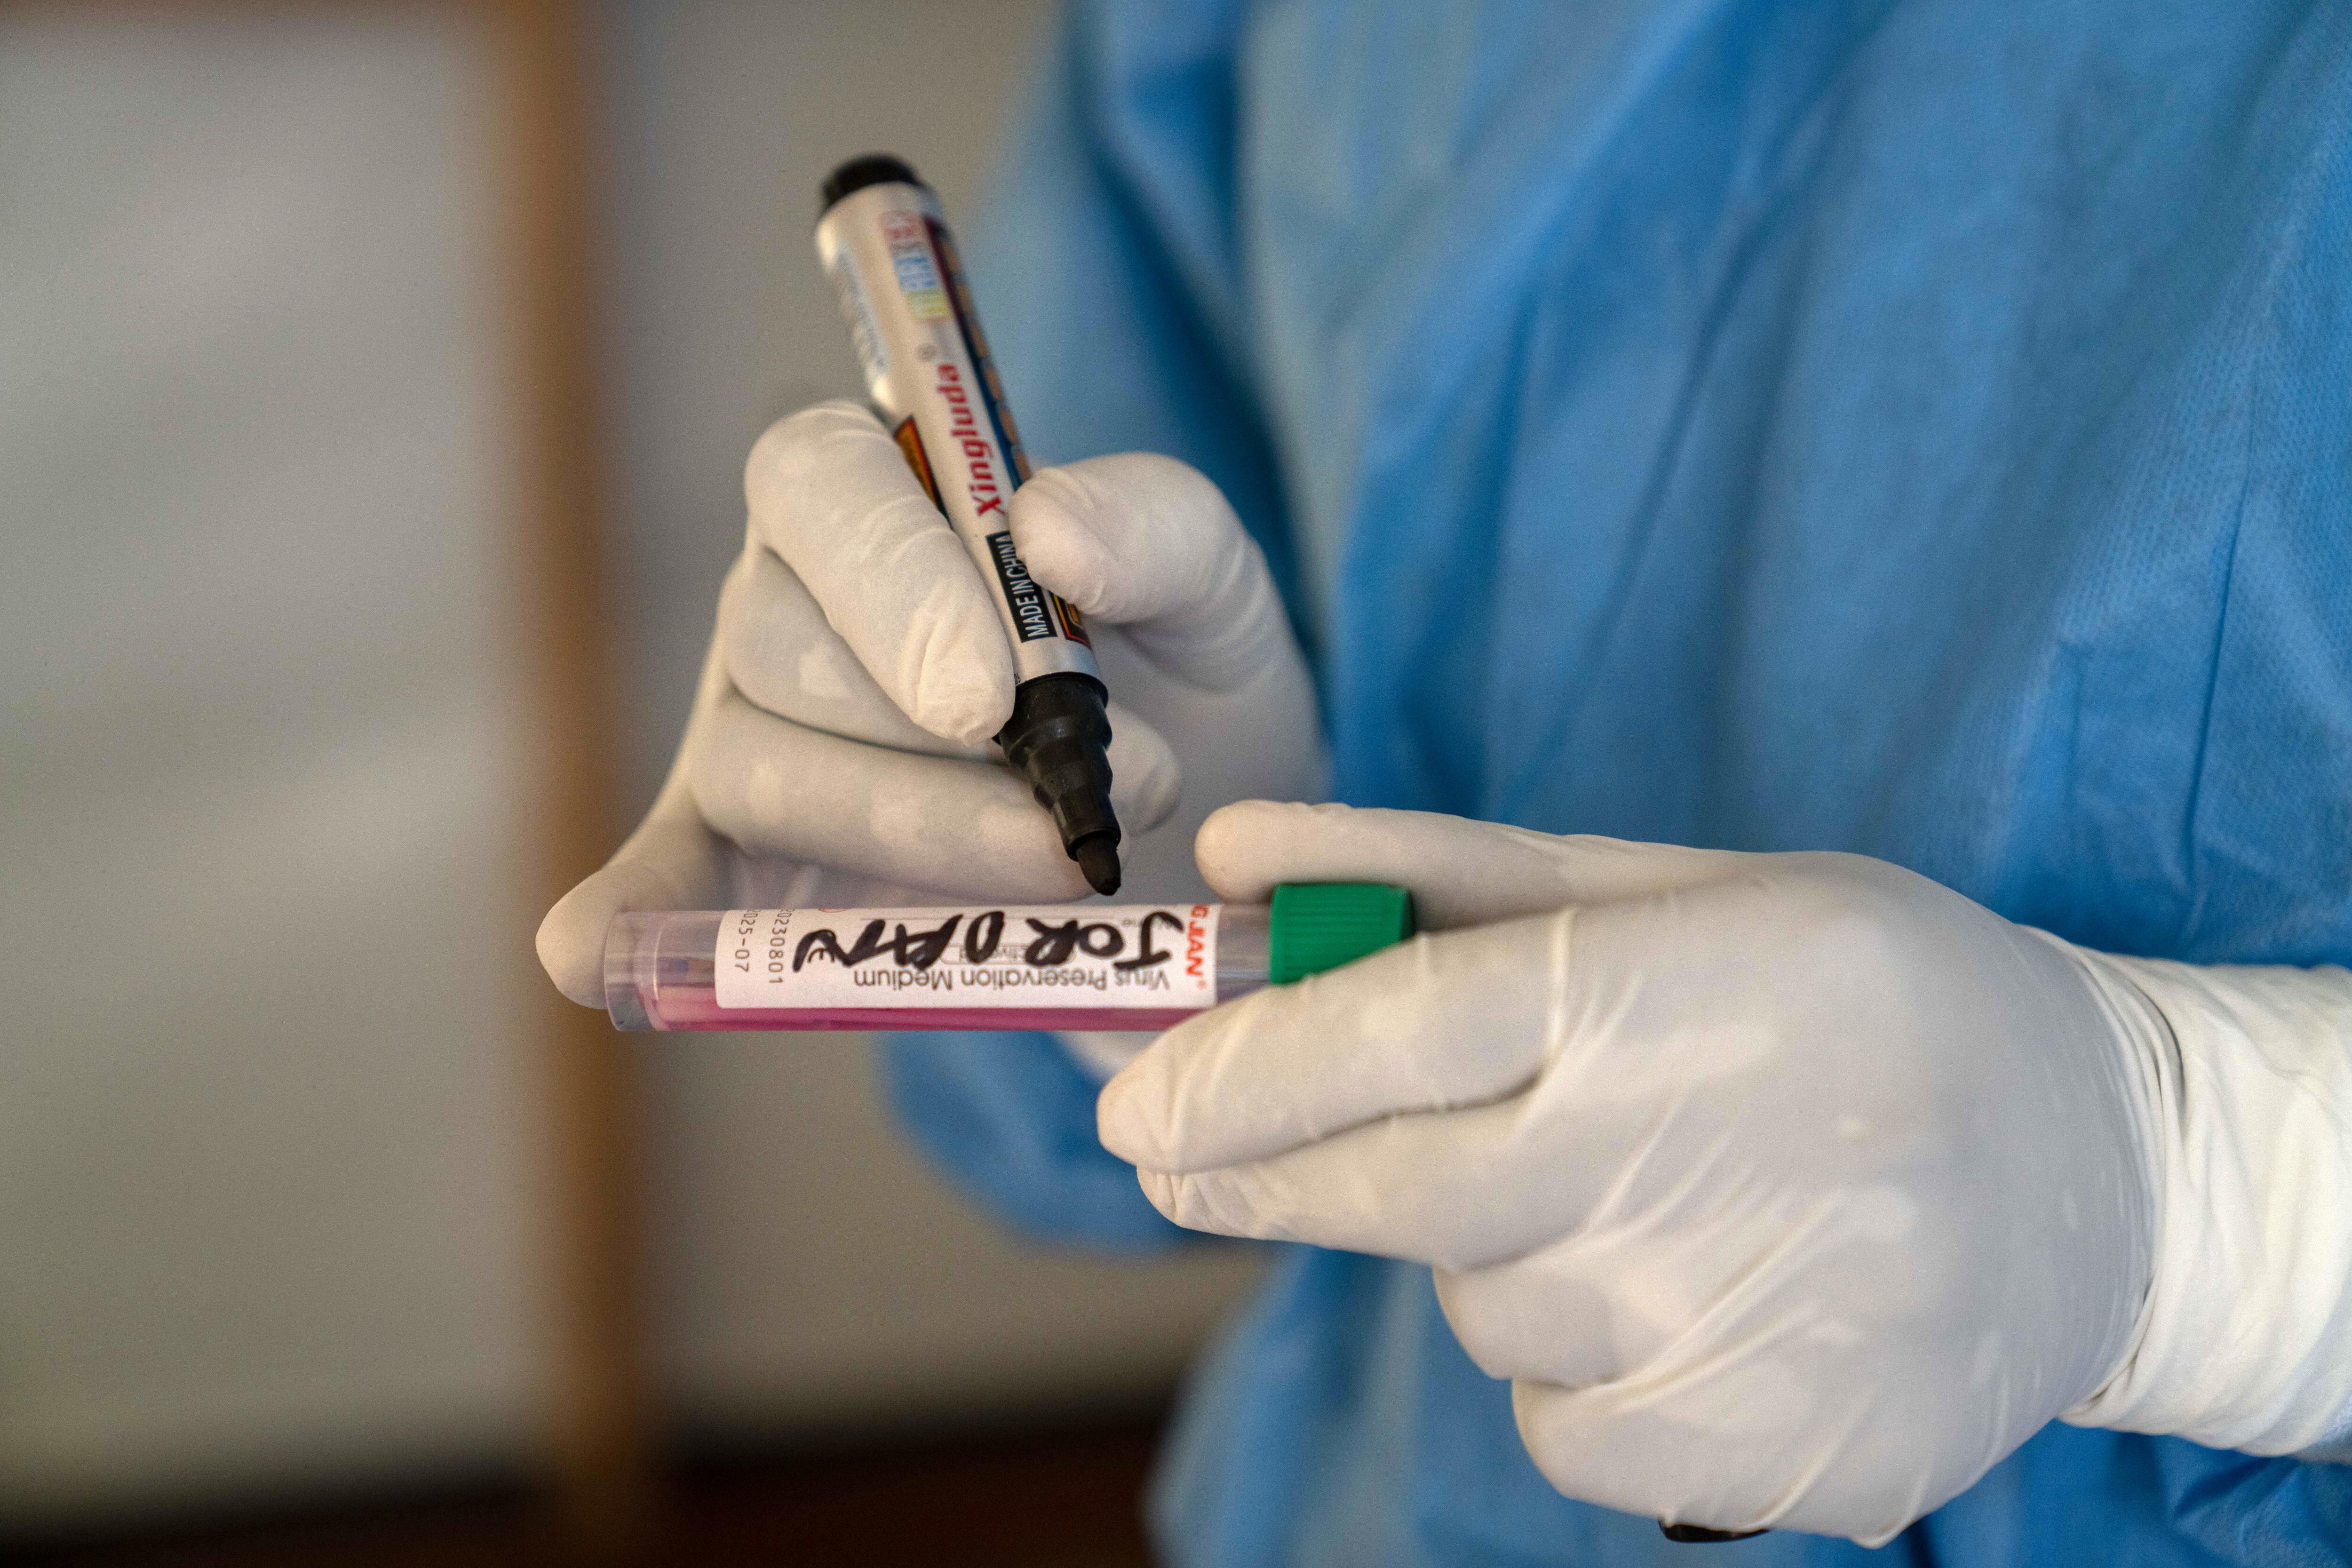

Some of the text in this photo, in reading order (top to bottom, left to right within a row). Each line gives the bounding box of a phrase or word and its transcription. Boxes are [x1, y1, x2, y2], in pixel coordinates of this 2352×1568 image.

[936, 363, 1006, 517] Xingluda
[1009, 578, 1035, 595] IN
[1015, 595, 1049, 637] MADE
[853, 966, 1171, 991] Virus Preservation Medium
